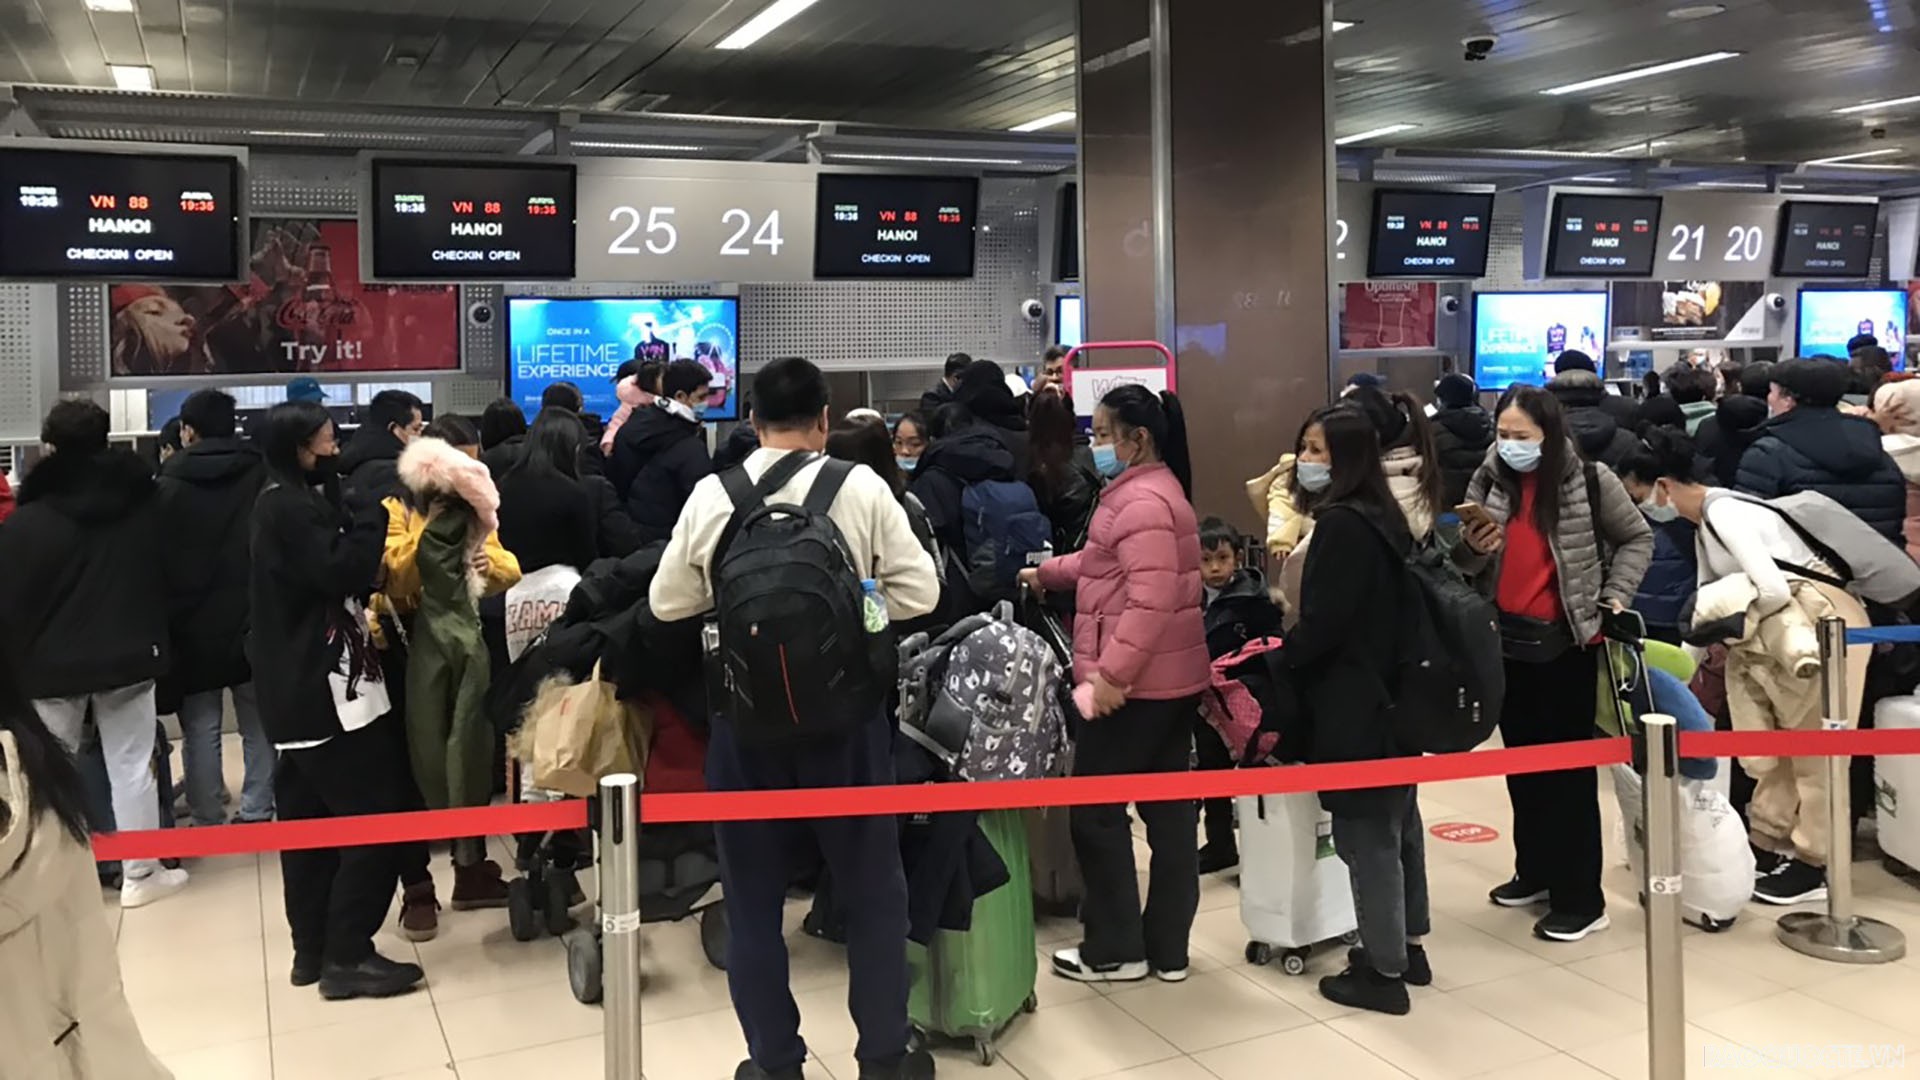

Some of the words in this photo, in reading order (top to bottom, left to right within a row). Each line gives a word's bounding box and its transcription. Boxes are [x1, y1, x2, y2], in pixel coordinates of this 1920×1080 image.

[90, 194, 116, 209] VN
[128, 195, 149, 210] 88
[180, 199, 215, 212] 19:35
[452, 201, 473, 213] VN
[484, 201, 501, 214] 88
[527, 205, 557, 215] 19:35
[879, 211, 896, 221] VN
[904, 211, 918, 222] 88
[89, 218, 151, 233] HANOI
[451, 223, 502, 235] HANOI
[608, 206, 676, 253] 25
[720, 209, 783, 255] 24
[878, 230, 917, 241] HANOI
[1416, 236, 1447, 247] HANOI
[1591, 237, 1620, 248] HANOI
[1668, 225, 1704, 261] 21
[1724, 226, 1763, 261] 20
[66, 247, 130, 261] CHECKIN
[134, 248, 174, 261] OPEN
[431, 250, 484, 261] CHECKIN
[488, 250, 521, 261] OPEN
[861, 253, 902, 263] CHECKIN
[904, 254, 931, 263] OPEN
[1435, 257, 1455, 266] OPEN
[546, 327, 572, 336] ONCE
[573, 328, 583, 336] IN
[280, 341, 327, 364] Try
[336, 339, 363, 360] it!
[516, 343, 620, 363] LIFETIME
[517, 363, 618, 379] EXPERIENCE
